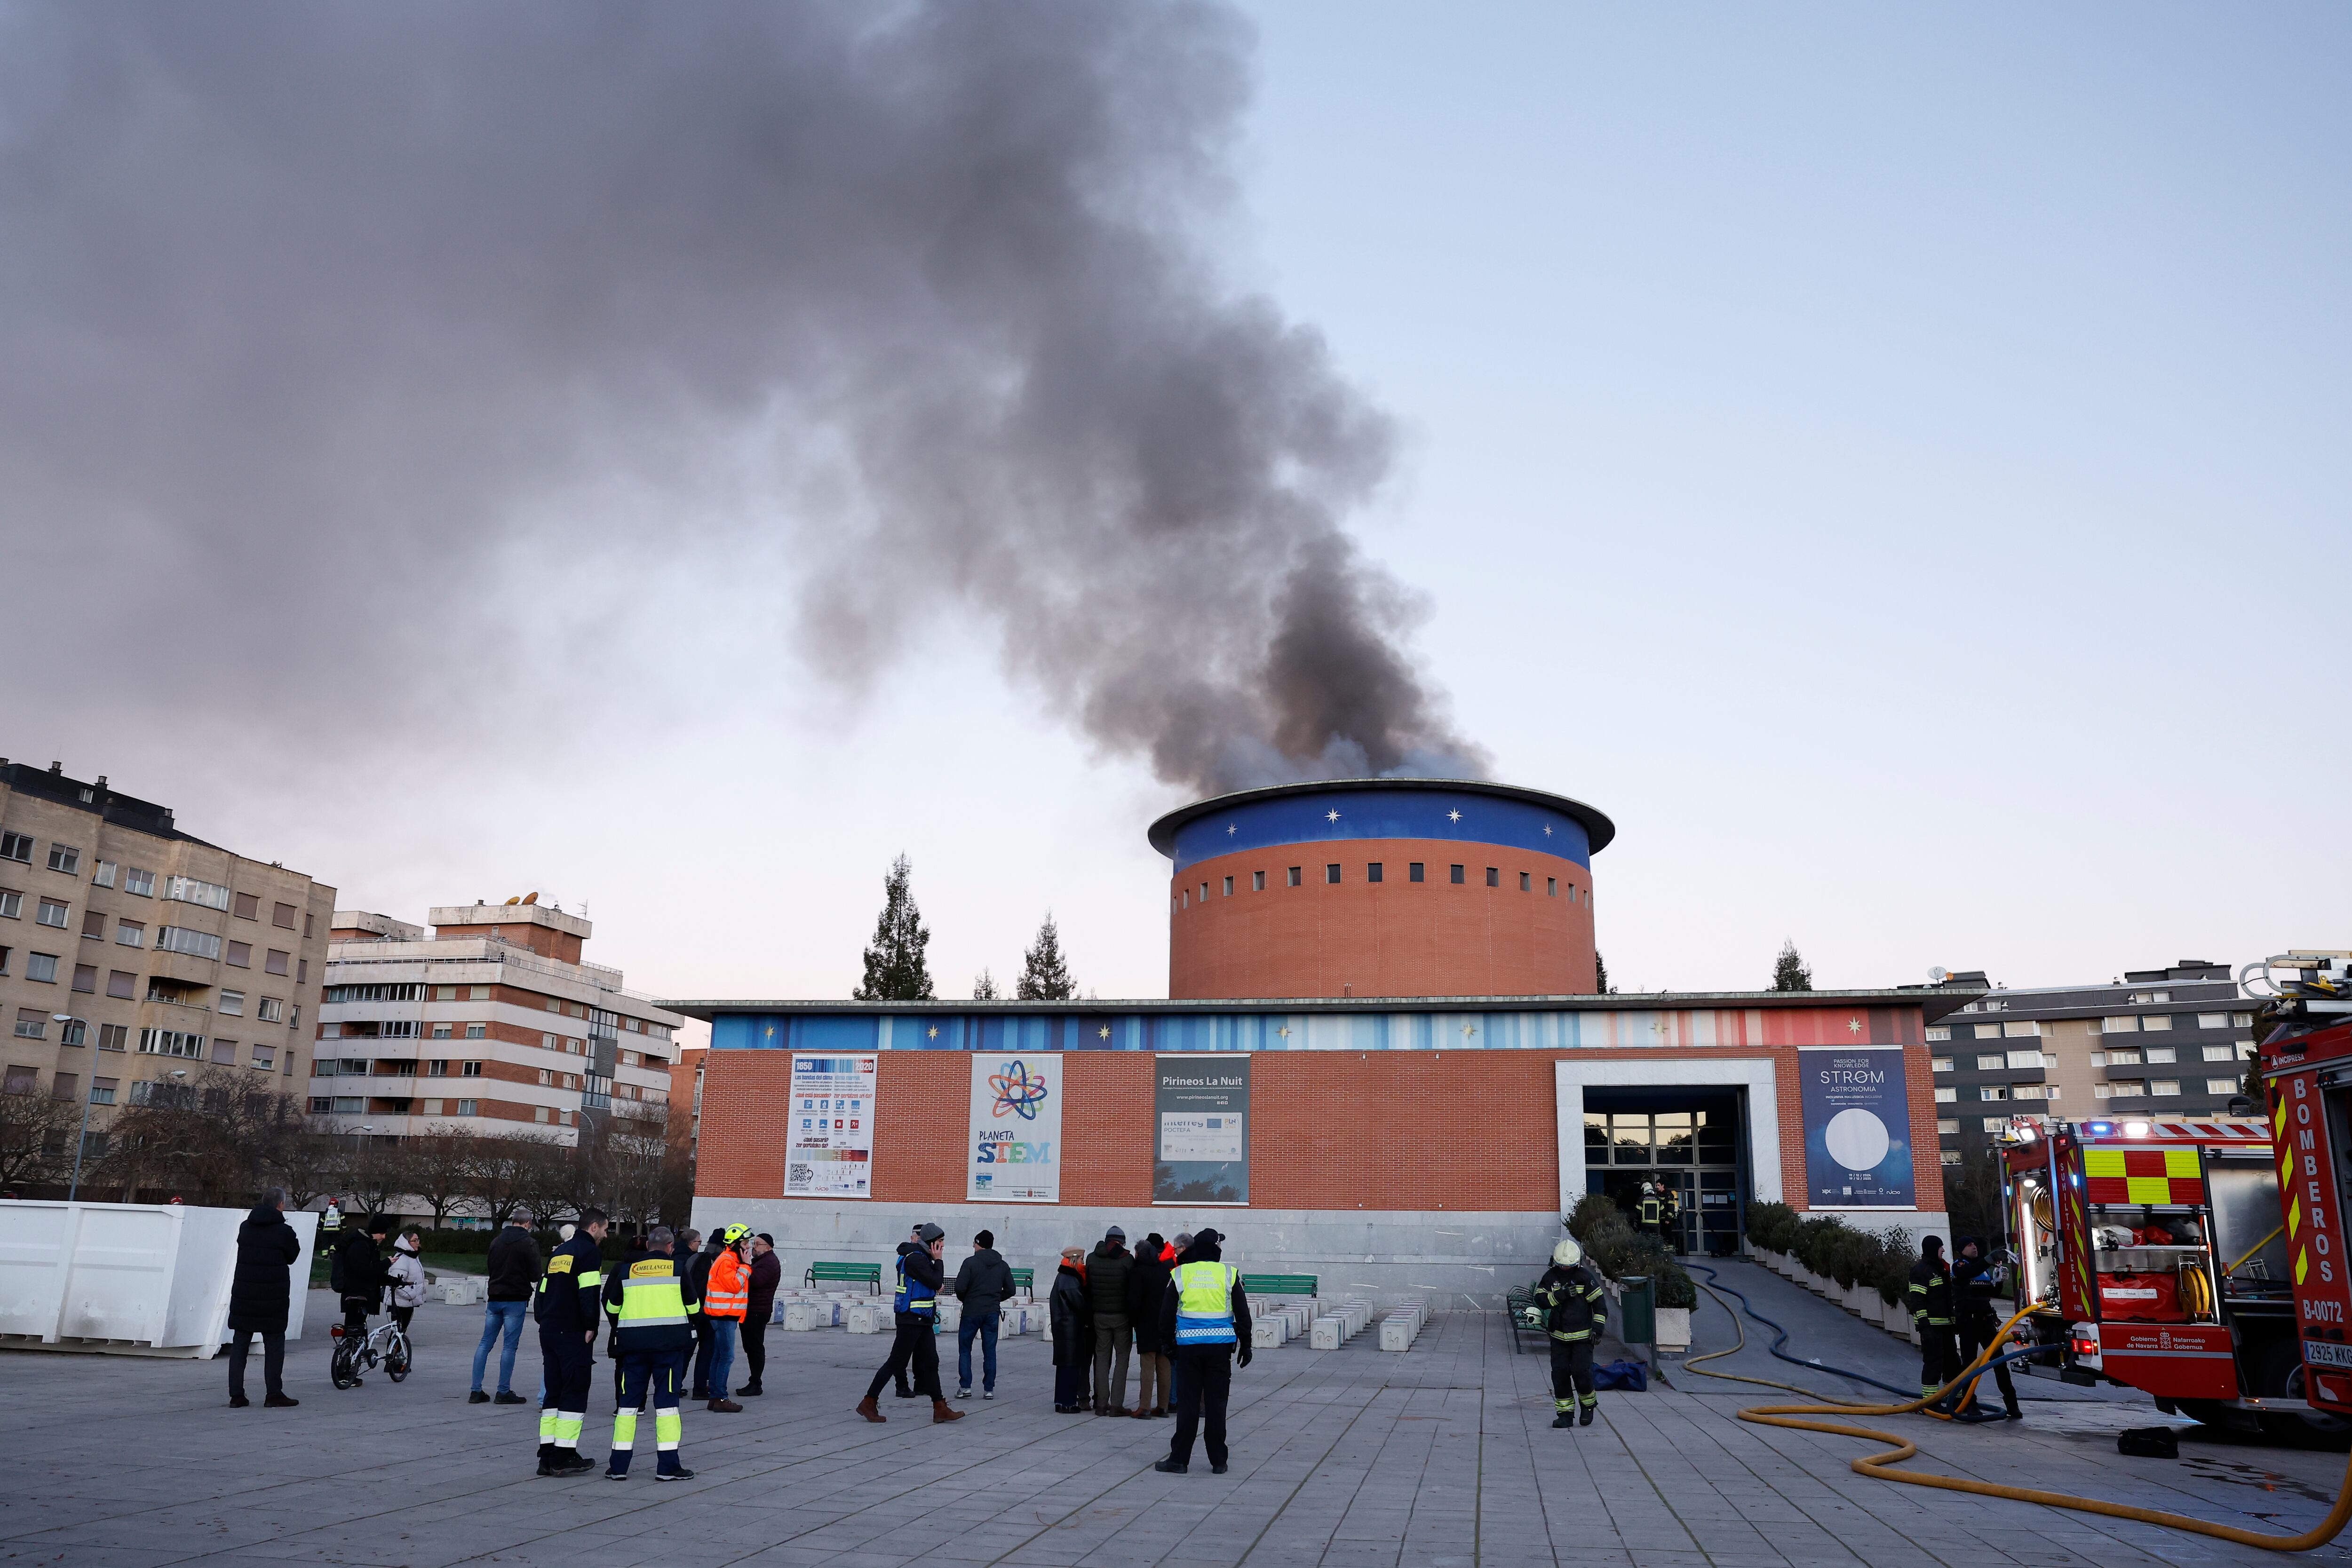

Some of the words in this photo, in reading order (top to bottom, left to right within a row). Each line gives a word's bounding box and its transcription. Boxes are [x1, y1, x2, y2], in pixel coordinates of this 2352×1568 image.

[2279, 1053, 2305, 1065] INCIPRESA
[796, 1061, 813, 1070] 1850
[855, 1062, 873, 1071] 2020
[1163, 1076, 1204, 1085] Pirineos
[1206, 1077, 1218, 1085] La
[1221, 1076, 1242, 1085] Nuit
[979, 1131, 1015, 1141] PLANETA
[977, 1142, 1051, 1164] STEM
[2294, 1078, 2333, 1283] BOMBEROS
[2303, 1299, 2344, 1323] B-0072
[2310, 1344, 2333, 1362] 2925
[2334, 1346, 2352, 1364] KKG
